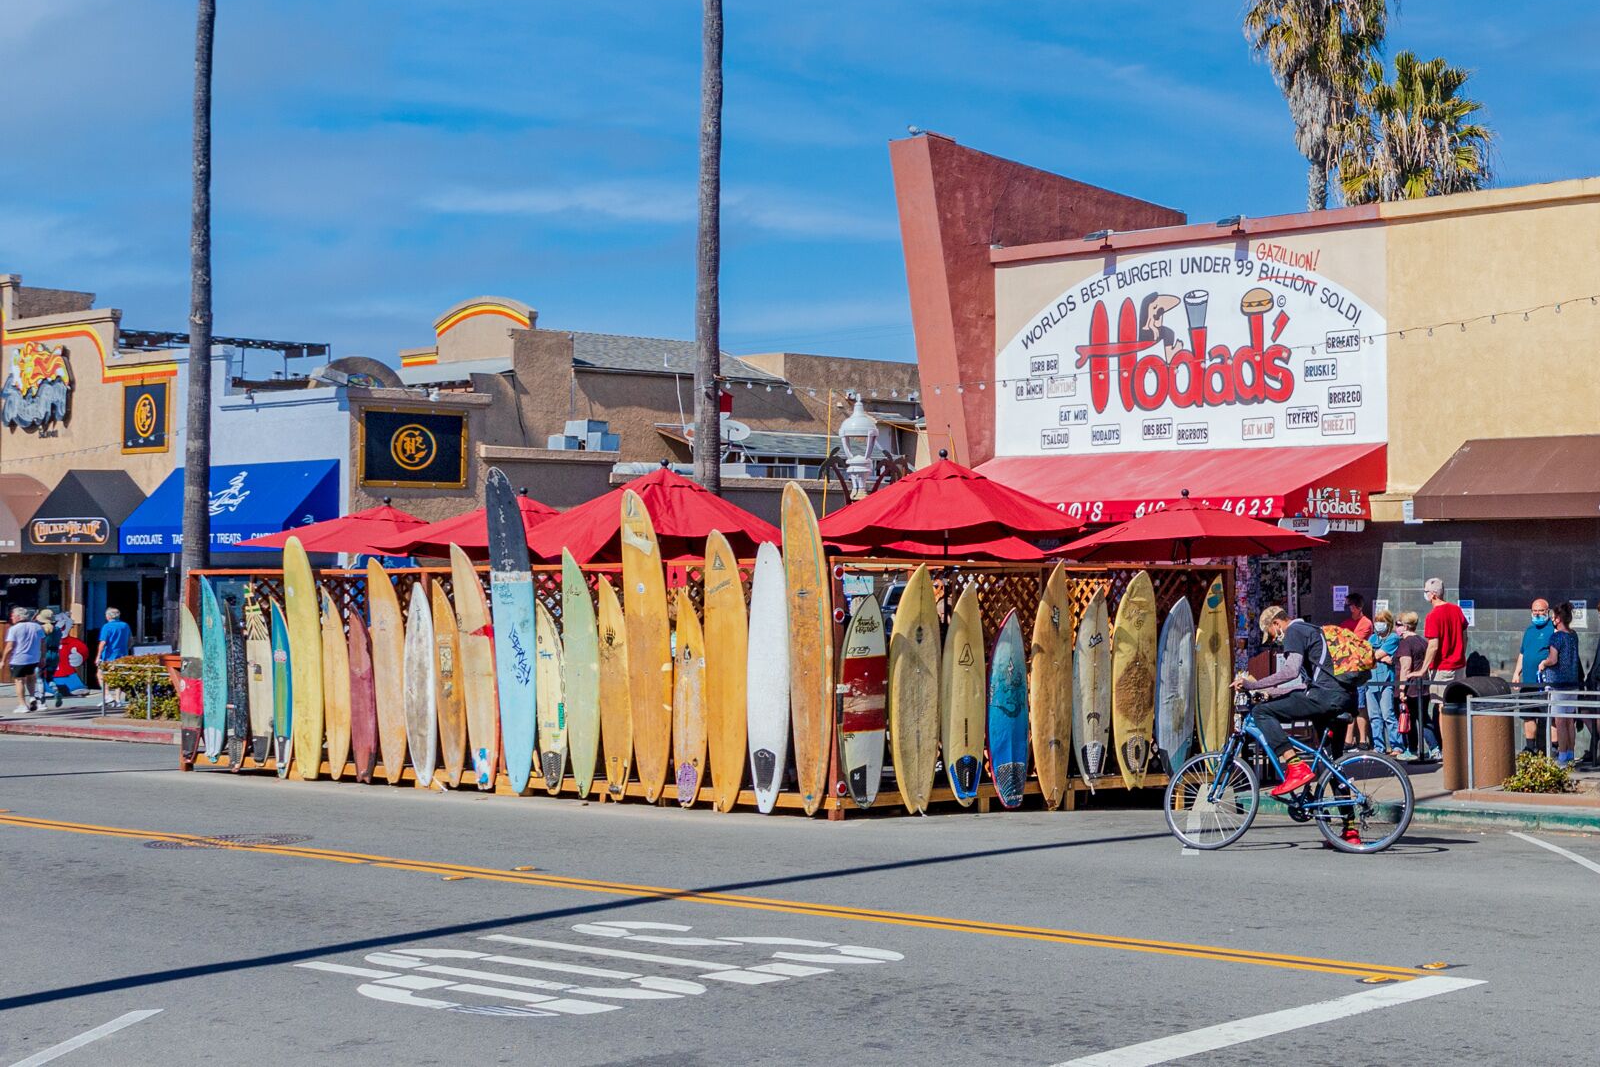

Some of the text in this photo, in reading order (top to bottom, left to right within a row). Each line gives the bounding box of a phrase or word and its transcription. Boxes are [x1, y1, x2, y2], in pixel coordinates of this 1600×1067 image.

[1256, 242, 1320, 271] GAZILLION!
[1021, 256, 1362, 350] WORLDS BEST BURGER! UNDER 99 BILLION SOLD!
[1330, 364, 1337, 376] 2
[1060, 410, 1072, 422] EAT
[1287, 410, 1318, 425] TRY FRYS
[1156, 421, 1172, 435] BEST
[1243, 422, 1255, 436] EAT
[126, 534, 163, 545] CHOCOLATE
[217, 533, 241, 544] TREATS
[9, 578, 37, 586] LOTTO
